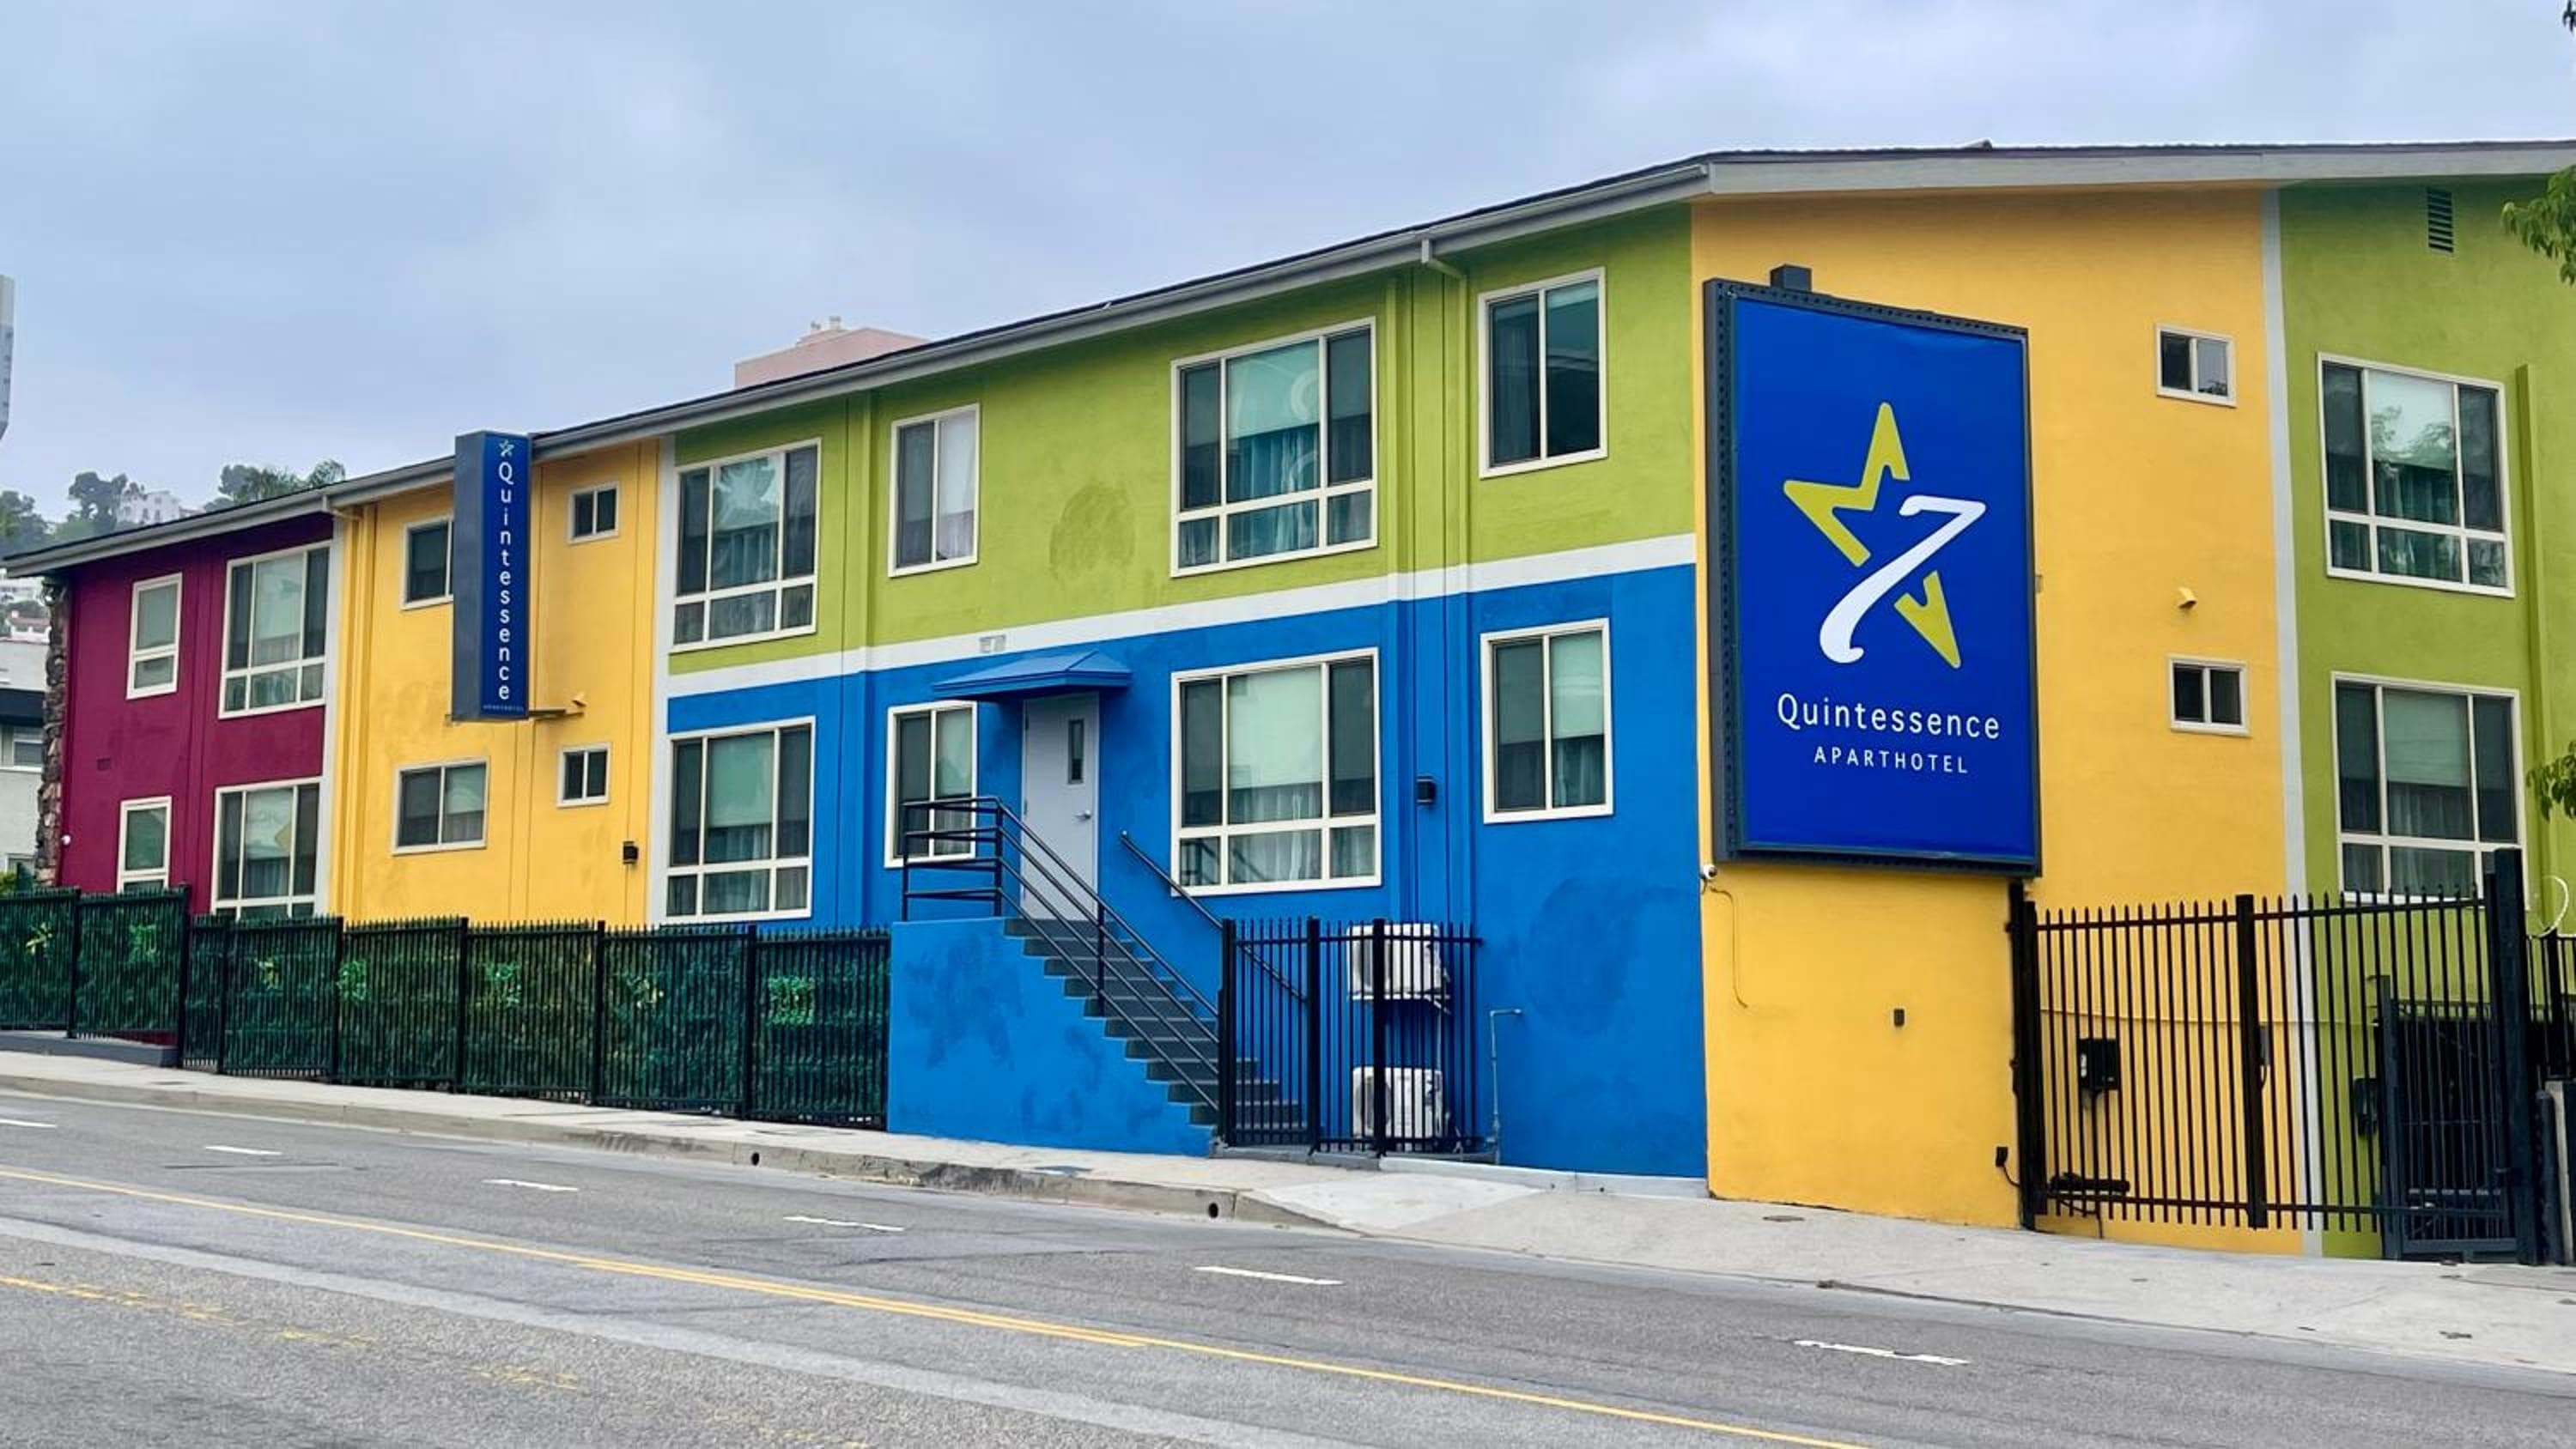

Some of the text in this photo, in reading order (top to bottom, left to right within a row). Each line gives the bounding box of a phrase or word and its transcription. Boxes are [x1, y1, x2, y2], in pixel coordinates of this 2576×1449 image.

[498, 461, 514, 700] Quintessence
[1819, 494, 1987, 664] 7
[1777, 693, 2000, 739] Quintessence
[1814, 746, 1968, 773] APARTHOTEL
